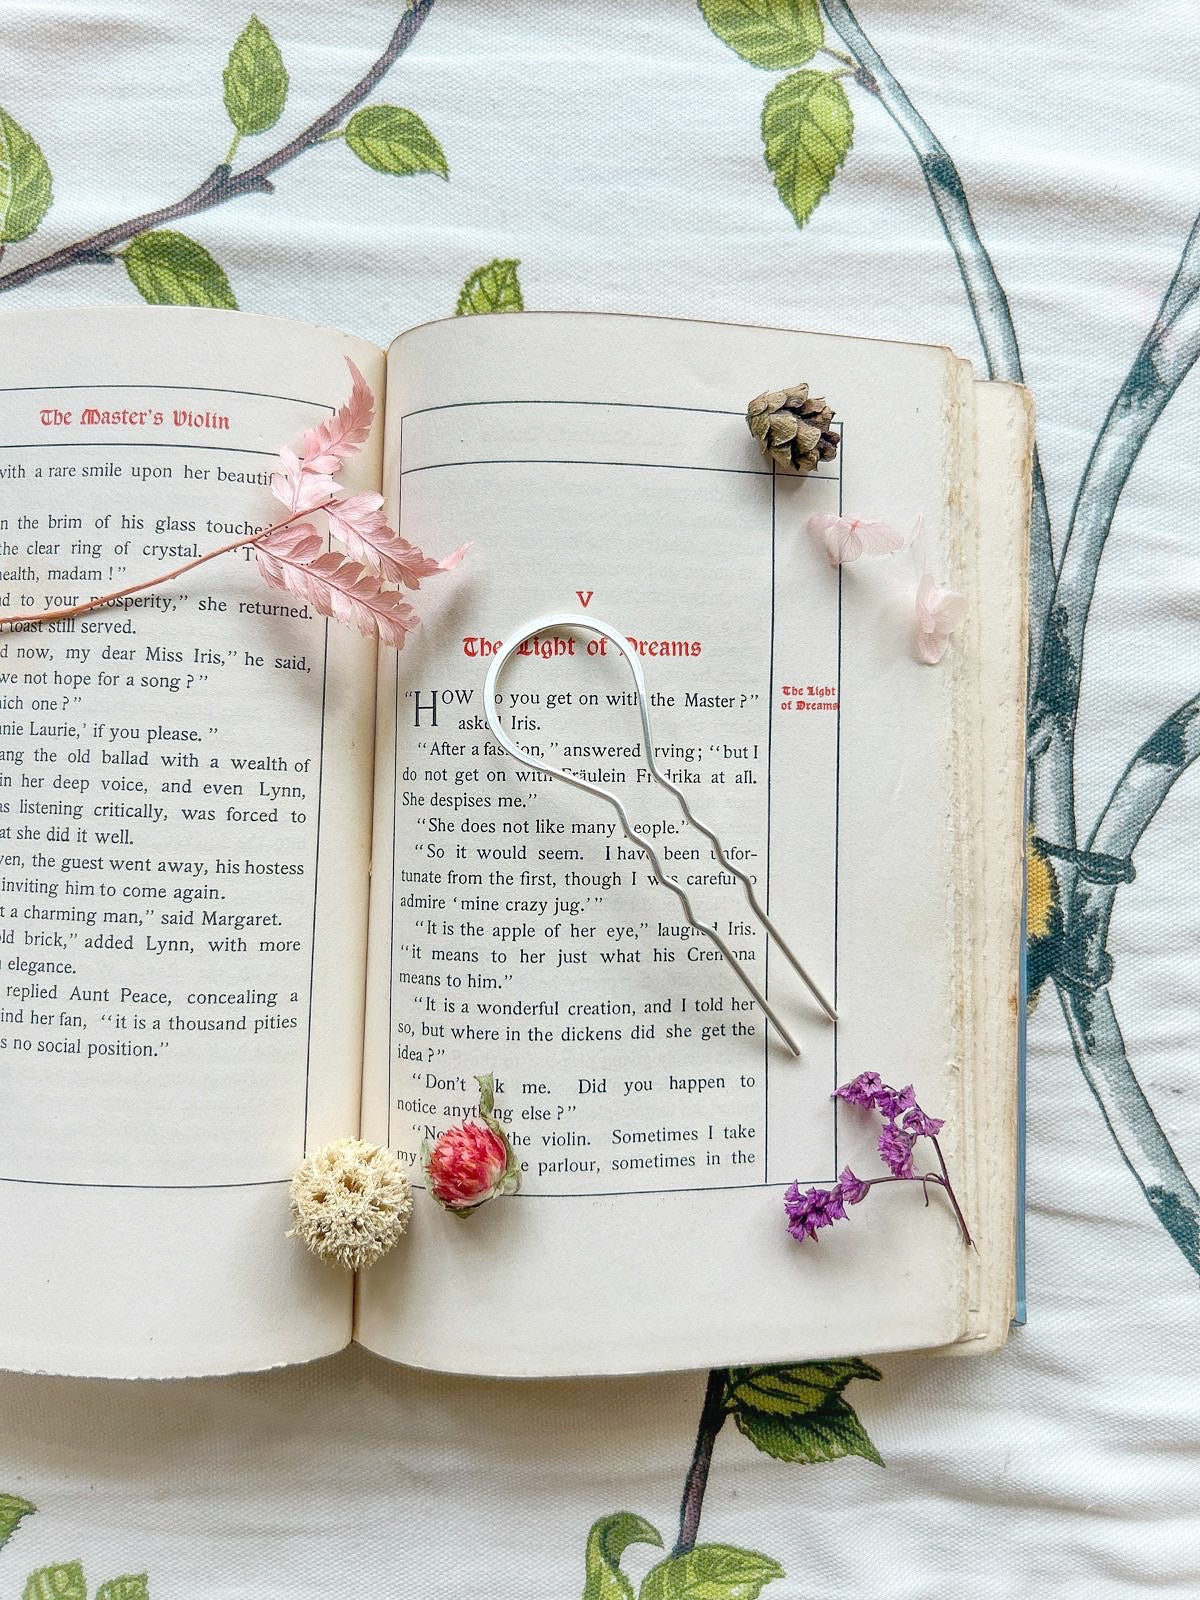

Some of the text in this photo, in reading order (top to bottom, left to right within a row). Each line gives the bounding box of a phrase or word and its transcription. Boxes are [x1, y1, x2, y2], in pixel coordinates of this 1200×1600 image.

[40, 409, 72, 426] The
[173, 410, 230, 430] Violin
[48, 462, 211, 482] rare smile upon her
[17, 514, 196, 534] the brim of his glass
[26, 539, 202, 561] clear ring of crystal.
[20, 594, 314, 620] to your she returned.
[575, 591, 594, 608] V
[48, 618, 136, 634] still served.
[462, 637, 503, 657] The
[517, 637, 576, 660] Light
[586, 637, 608, 656] of
[17, 645, 311, 674] now, my dear Miss he said,
[24, 670, 120, 690] not hope for
[509, 693, 540, 708] you
[546, 692, 572, 709] get
[579, 694, 599, 705] on
[650, 692, 675, 707] the
[781, 686, 836, 698] The Light
[781, 700, 840, 711] of Dreams
[511, 715, 541, 731] Iris.
[109, 728, 140, 743] you
[33, 747, 311, 773] the old ballad with wealth of
[563, 743, 641, 758] answered
[21, 773, 306, 801] her deep voice, and even Lynn,
[425, 768, 757, 786] not get on all.
[19, 799, 306, 823] listening critically, was forced to
[402, 791, 491, 811] She despises
[16, 825, 134, 845] she did well.
[461, 818, 616, 838] does not like many
[476, 845, 700, 860] would seem. been
[32, 852, 304, 877] the guest went away, his hostess
[401, 869, 622, 890] tunate from the first, though
[1, 877, 226, 904] inviting him to come again.
[400, 893, 548, 916] admire crazy
[24, 904, 282, 930] charming said Margaret.
[460, 921, 756, 942] the apple of her Iris.
[84, 934, 301, 955] added Lynn, with more
[8, 956, 76, 976] elegance.
[432, 947, 675, 968] means to her just what his
[399, 972, 462, 988] means to
[7, 983, 278, 1008] replied Aunt Peace, concealing
[476, 997, 756, 1017] wonderful creation, and told her
[30, 1010, 297, 1034] her fan, thousand pities
[398, 1021, 755, 1042] so, but where in the dickens did she get the
[37, 1038, 81, 1054] social
[522, 1083, 551, 1094] me.
[578, 1078, 607, 1095] Did
[623, 1080, 653, 1097] you
[669, 1075, 725, 1094] happen
[397, 1098, 436, 1115] notice
[541, 1124, 755, 1147] violin. Sometimes take
[397, 1150, 417, 1167] my
[538, 1158, 600, 1176] parlour,
[612, 1153, 696, 1171] sometimes
[706, 1151, 721, 1166] in
[731, 1150, 755, 1165] the
